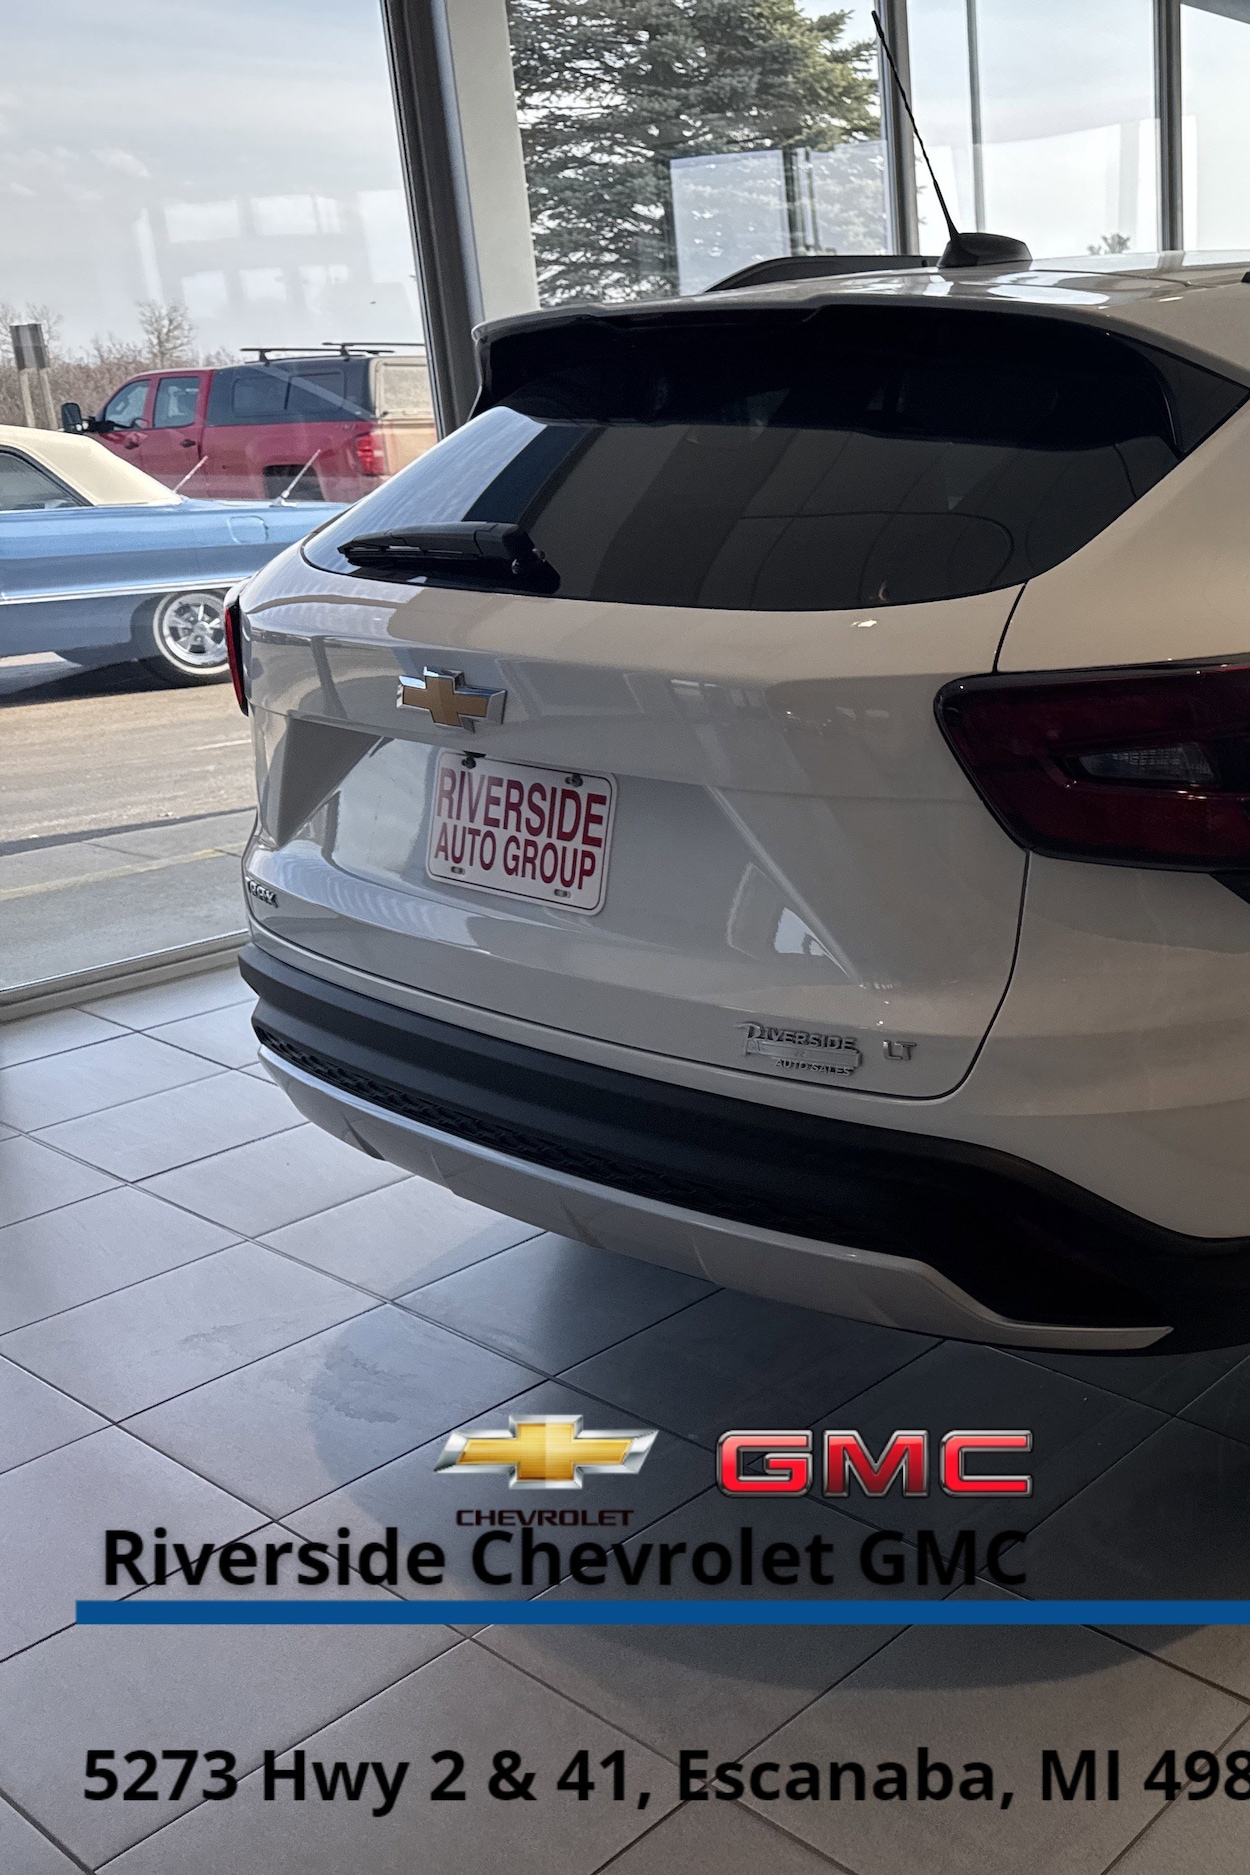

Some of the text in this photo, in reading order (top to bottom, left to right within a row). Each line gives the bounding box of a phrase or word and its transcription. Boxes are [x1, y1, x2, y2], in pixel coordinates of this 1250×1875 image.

[436, 767, 607, 848] RIVERSIDE
[434, 822, 596, 890] AUTO GROUP
[735, 1021, 858, 1056] RIVERSIDE
[883, 1038, 917, 1062] LT
[775, 1057, 852, 1076] AUTO SALES
